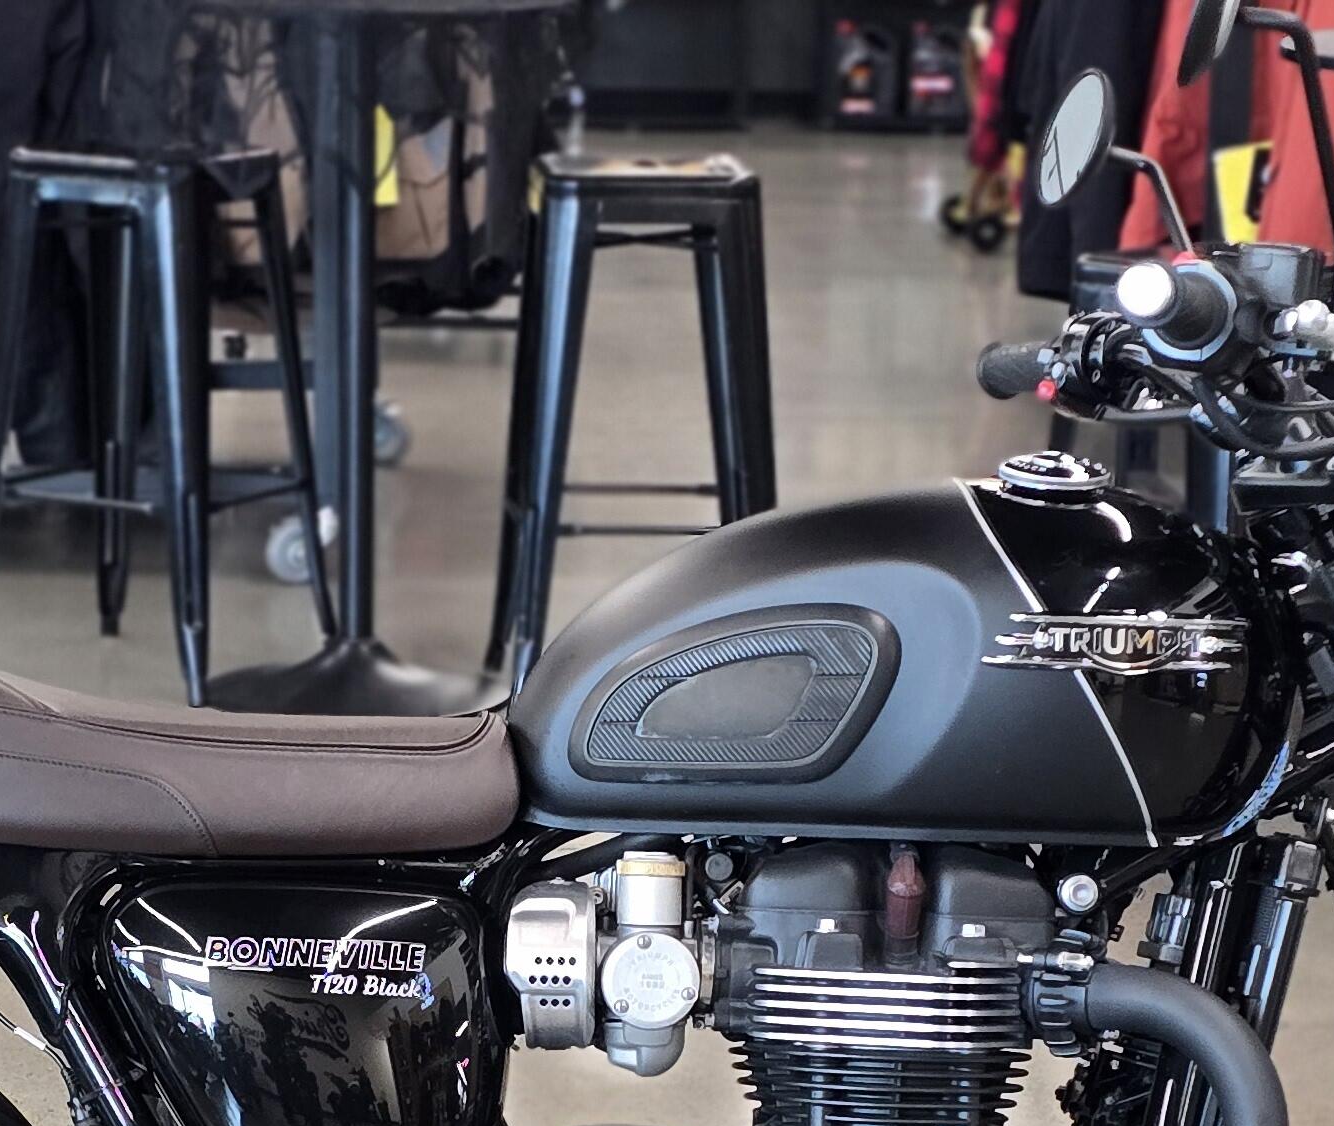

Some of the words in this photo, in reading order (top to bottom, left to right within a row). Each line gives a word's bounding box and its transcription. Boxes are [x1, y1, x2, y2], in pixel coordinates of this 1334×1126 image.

[1048, 627, 1201, 657] TRIUMPH
[204, 936, 426, 972] BONNEVILLE
[310, 974, 357, 995] T120
[362, 975, 421, 998] Black
